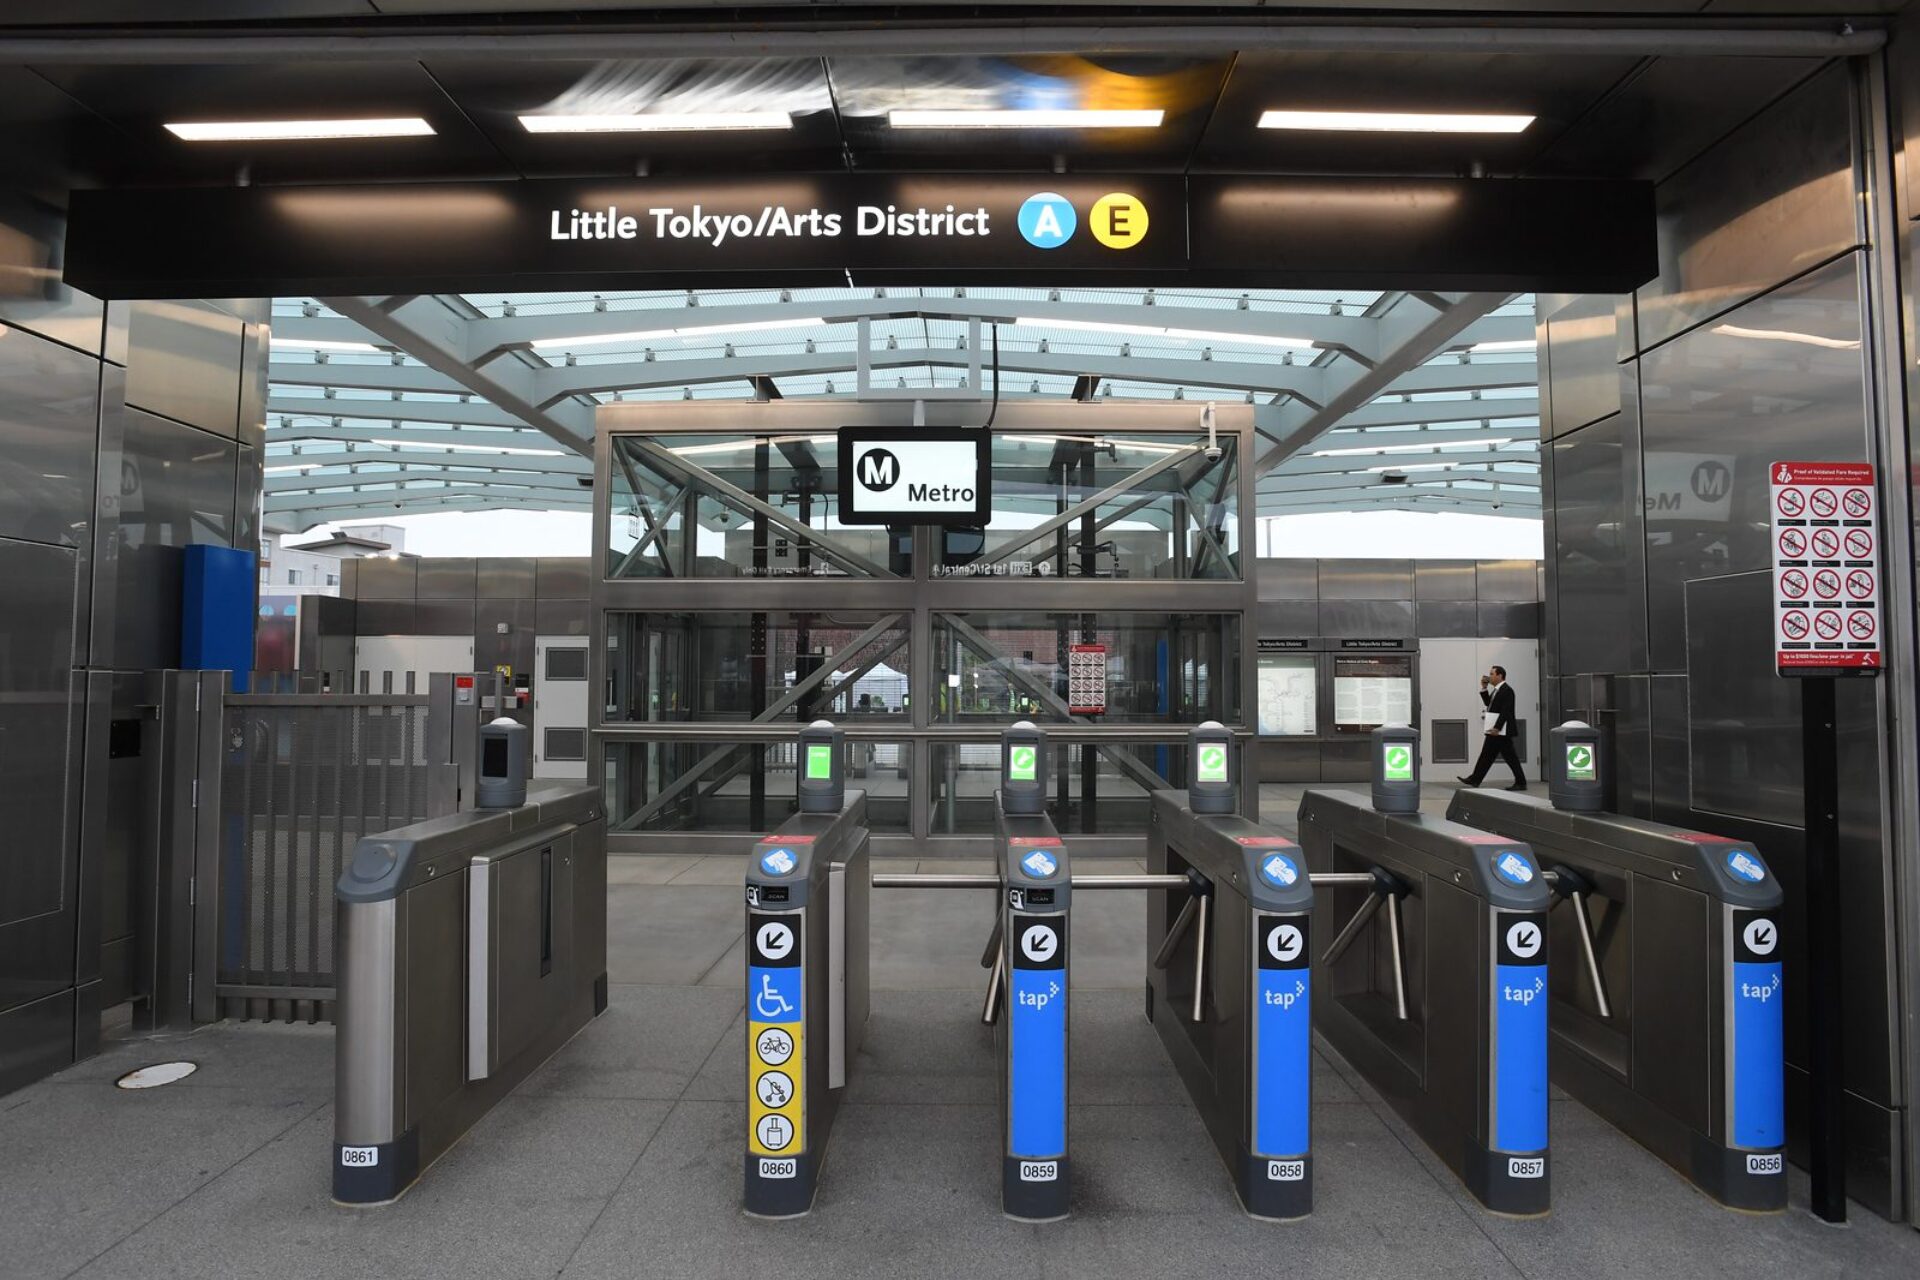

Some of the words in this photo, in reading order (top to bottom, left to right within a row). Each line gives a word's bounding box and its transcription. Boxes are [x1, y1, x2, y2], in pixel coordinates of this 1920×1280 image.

[551, 206, 638, 240] Little
[649, 205, 842, 247] Tokyo/Arts
[857, 205, 990, 236] District
[1032, 203, 1064, 238] A
[1108, 204, 1132, 237] E
[862, 454, 895, 487] M
[908, 483, 974, 502] Metro
[1019, 990, 1048, 1010] tap
[1265, 990, 1295, 1010] tap
[1504, 986, 1534, 1006] tap
[1742, 983, 1772, 1002] tap
[344, 1150, 373, 1163] 0861
[1750, 1157, 1780, 1171] 0856
[761, 1162, 793, 1175] 0860
[1023, 1165, 1055, 1178] 0859
[1271, 1164, 1302, 1178] 0858
[1511, 1162, 1542, 1175] 0857
